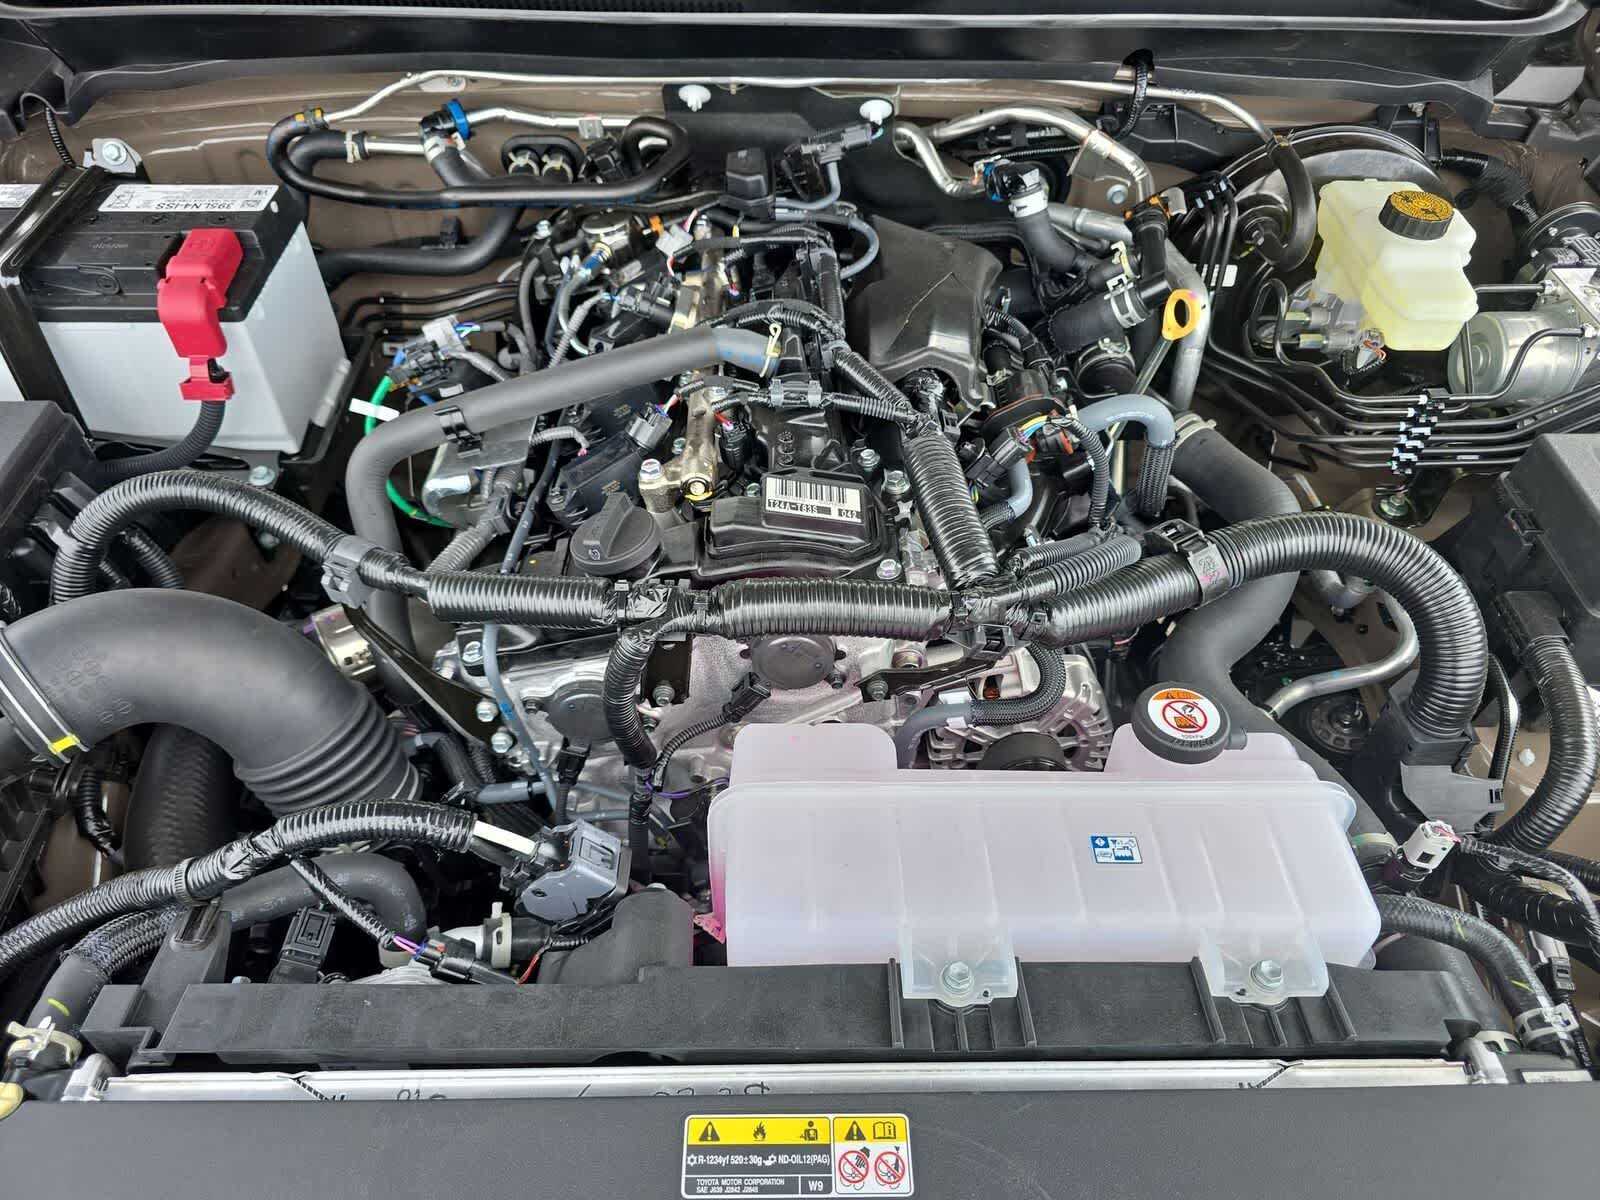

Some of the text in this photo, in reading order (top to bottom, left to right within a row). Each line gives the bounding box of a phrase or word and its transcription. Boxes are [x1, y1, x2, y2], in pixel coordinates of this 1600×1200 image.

[698, 1154, 729, 1167] R-1234yf
[778, 1154, 830, 1166] ND-OIL12(PAG)
[696, 1178, 785, 1186] TOYOTA MOTOR CORPORATION
[808, 1180, 824, 1192] W9
